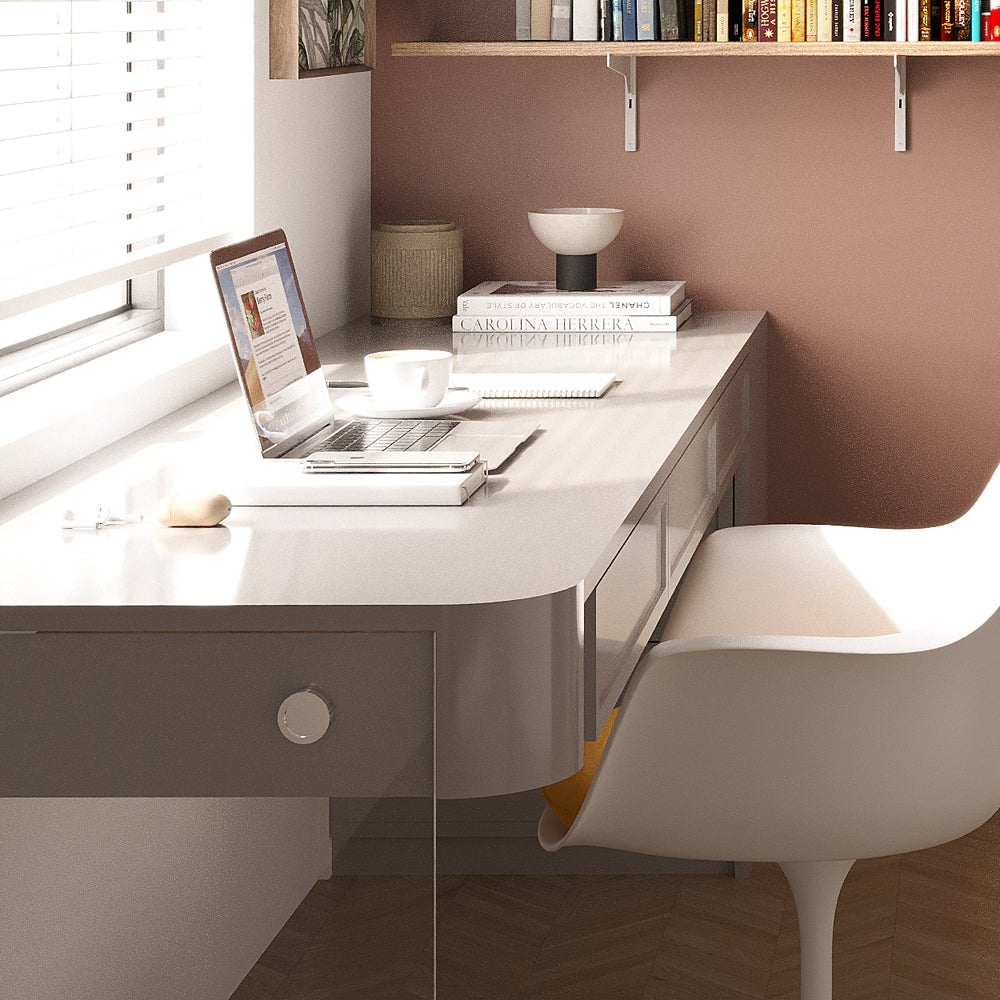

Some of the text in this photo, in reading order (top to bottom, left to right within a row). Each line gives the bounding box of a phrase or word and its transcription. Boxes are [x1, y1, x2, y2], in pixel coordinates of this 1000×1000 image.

[640, 0, 649, 14] ART
[460, 317, 634, 331] CAROLINA HERRERA
